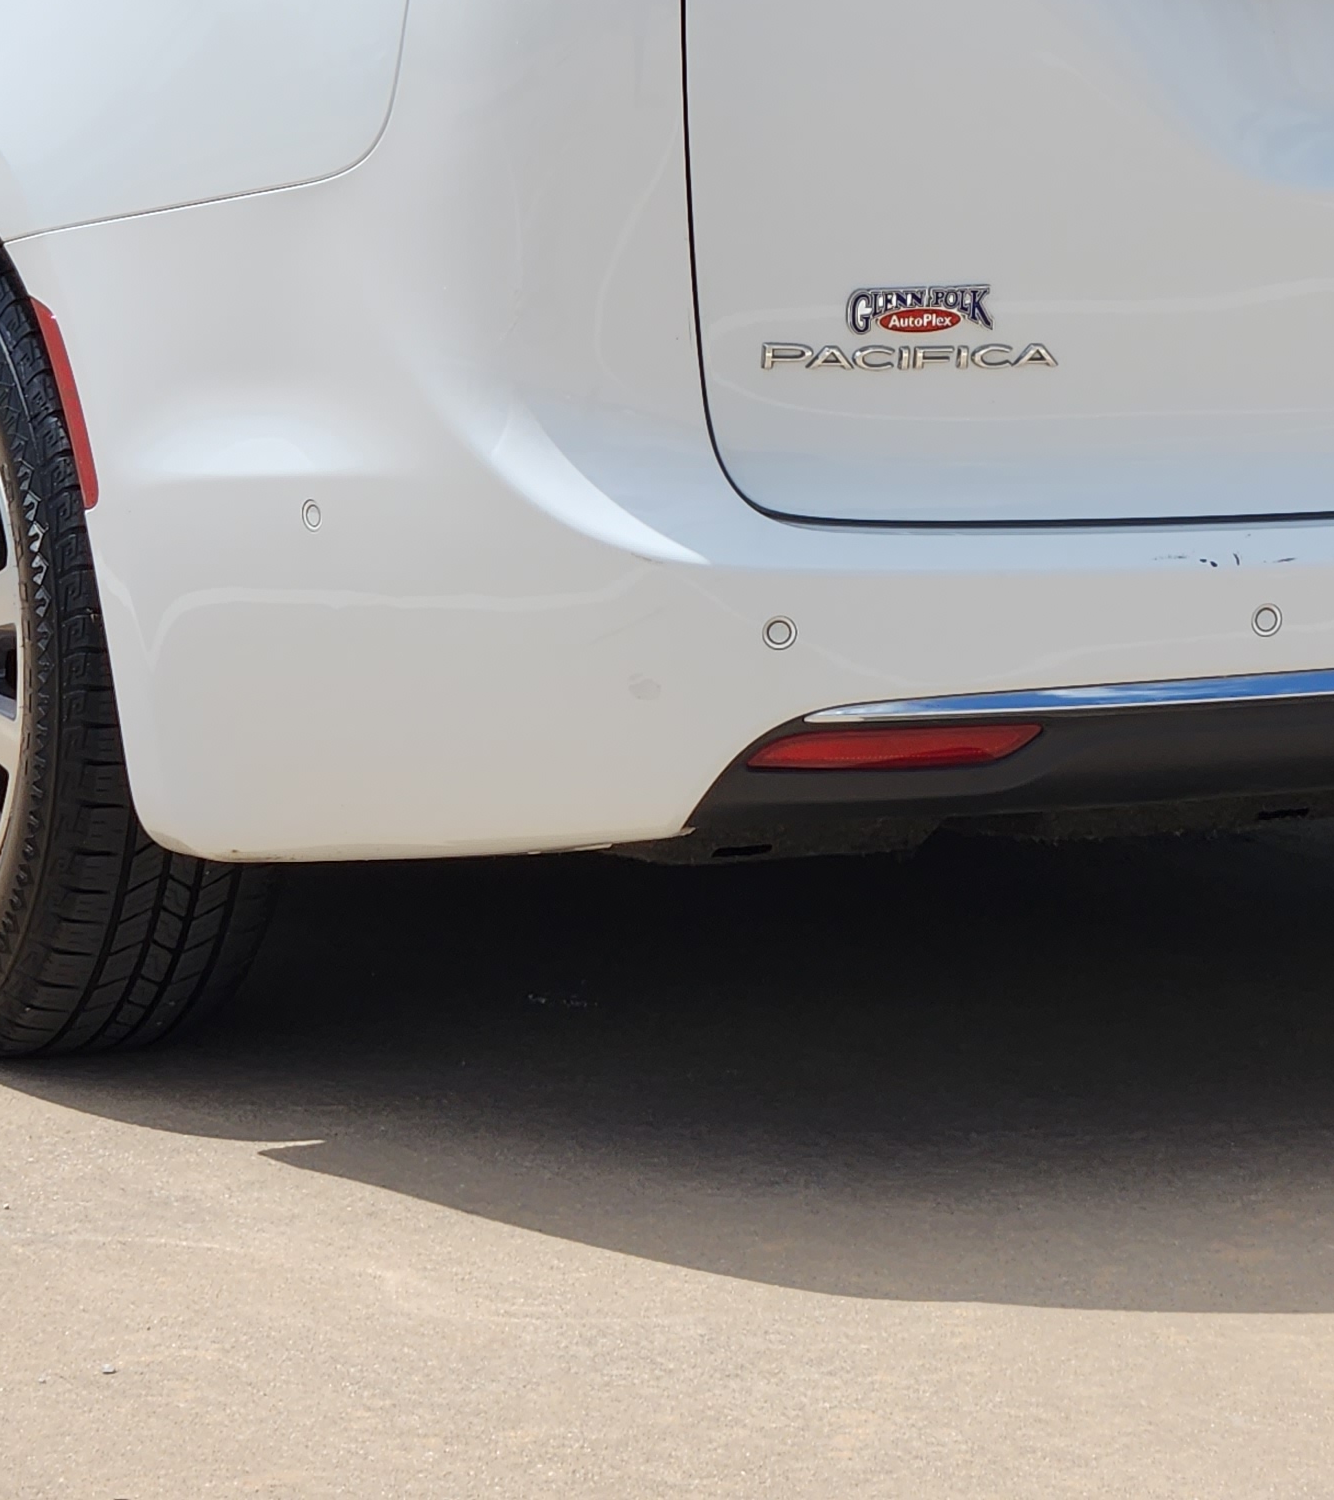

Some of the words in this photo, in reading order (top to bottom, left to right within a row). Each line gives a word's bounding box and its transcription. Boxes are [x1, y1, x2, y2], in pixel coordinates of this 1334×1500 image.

[846, 287, 928, 336] GLENN
[928, 283, 994, 331] POLK
[887, 313, 952, 329] AutoPlex
[760, 342, 1059, 371] PACIFICA
